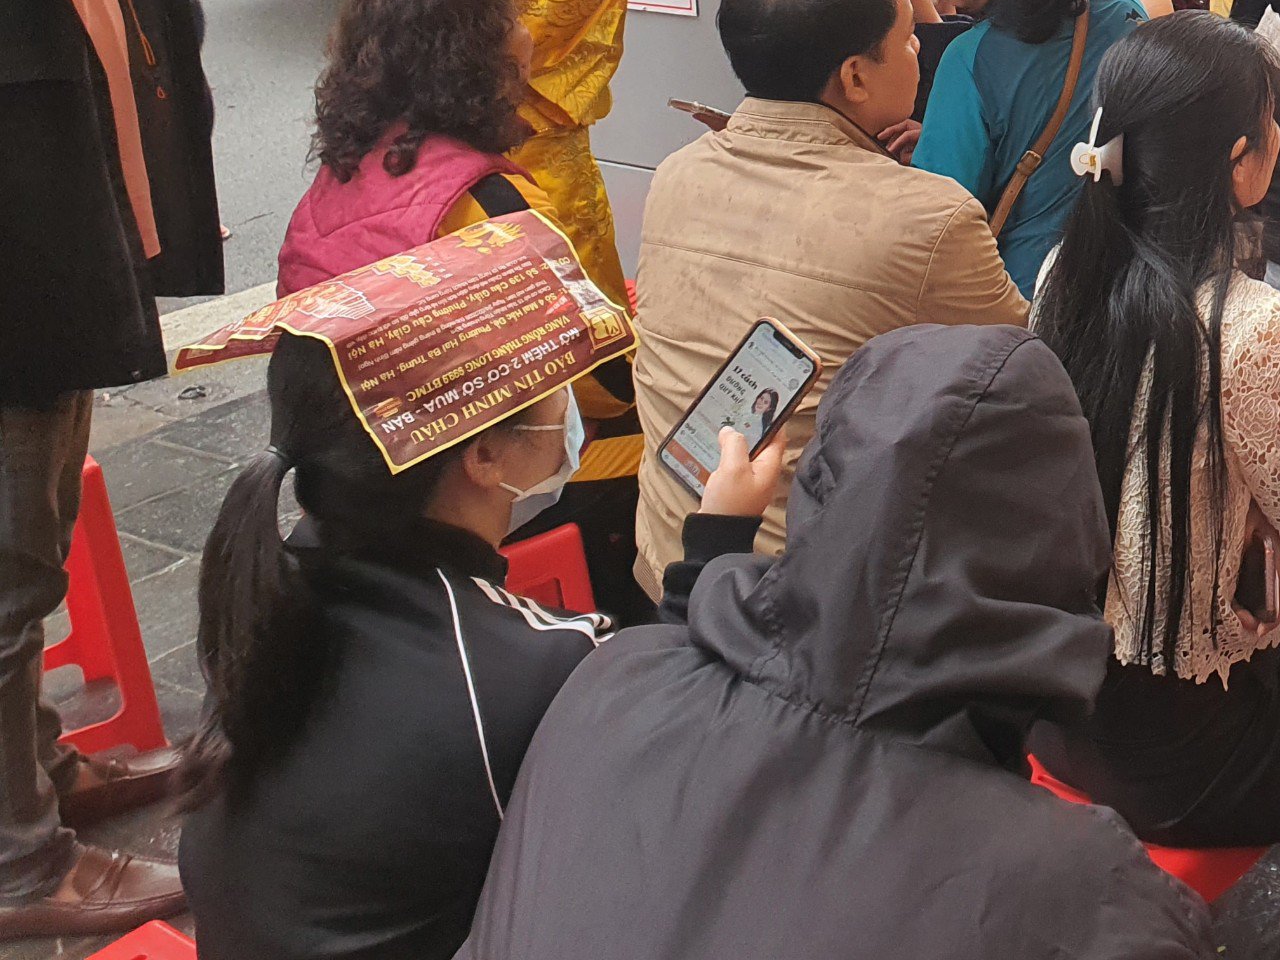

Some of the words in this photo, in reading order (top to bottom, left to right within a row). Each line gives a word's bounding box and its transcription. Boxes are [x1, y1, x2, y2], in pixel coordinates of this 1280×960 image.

[508, 273, 525, 285] 139
[525, 267, 539, 279] Số
[490, 280, 509, 295] Cầu
[537, 298, 544, 306] 4
[544, 292, 558, 304] Số
[432, 297, 466, 320] Phường
[506, 309, 523, 323] Hắc
[522, 302, 537, 313] Mai
[412, 313, 433, 329] Cầu
[544, 314, 569, 332] VÀNG
[458, 321, 490, 344] Phường
[520, 326, 546, 346] RỒNG
[347, 345, 367, 360] Nội
[367, 337, 384, 350] Hà
[441, 339, 458, 351] Hai
[491, 337, 522, 359] THĂNG
[521, 338, 558, 363] THÊM
[427, 347, 441, 359] Bà
[464, 352, 491, 371] LONG
[543, 351, 576, 378] BẢO
[359, 375, 378, 391] Nội
[379, 369, 395, 381] Hà
[512, 368, 545, 394] TÍN
[732, 365, 742, 375] 17
[740, 370, 760, 389] cách
[405, 378, 441, 401] BTMC
[459, 375, 485, 397] SỞ
[423, 388, 459, 413] MUA
[461, 385, 510, 417] MINH
[382, 410, 415, 435] BÁN
[410, 411, 460, 447] CHÂU
